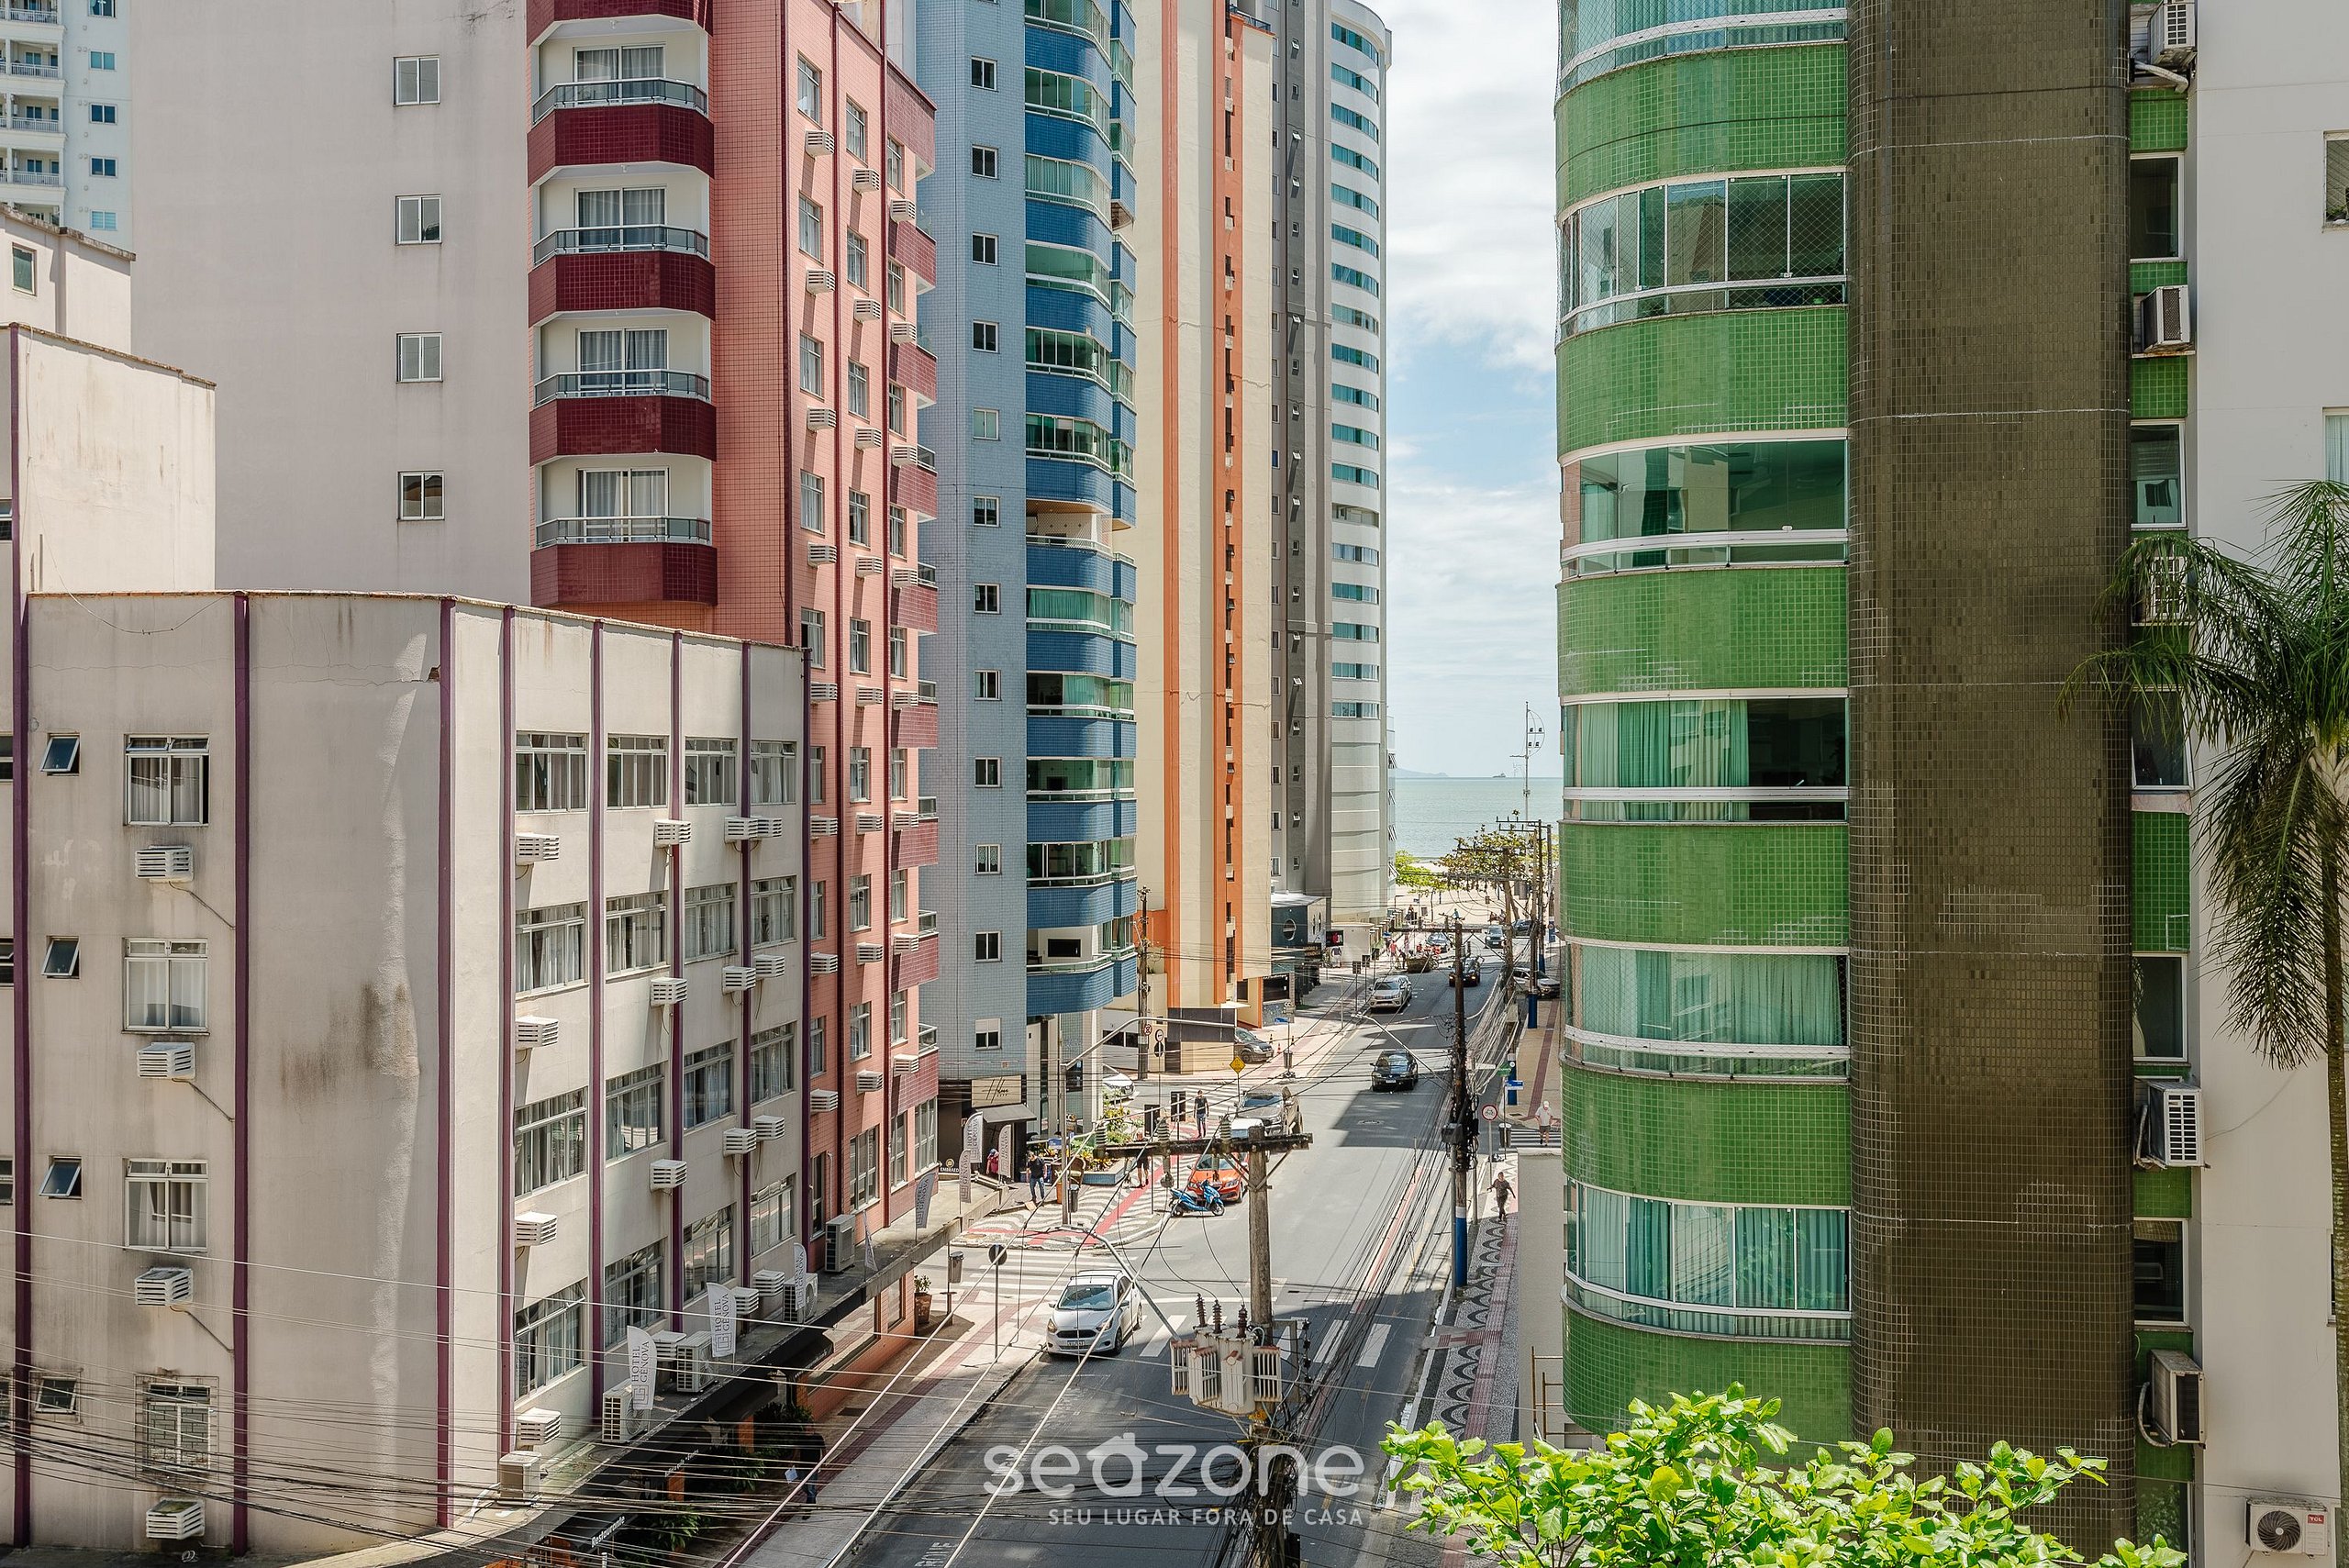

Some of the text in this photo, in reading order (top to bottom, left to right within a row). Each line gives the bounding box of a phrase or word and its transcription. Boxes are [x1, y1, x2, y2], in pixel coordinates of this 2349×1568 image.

[714, 1298, 722, 1332] HOTEL
[721, 1293, 729, 1331] GENOVA
[631, 1346, 640, 1382] HOTEL
[640, 1340, 650, 1383] GENOVA
[591, 1516, 626, 1548] Restaurante
